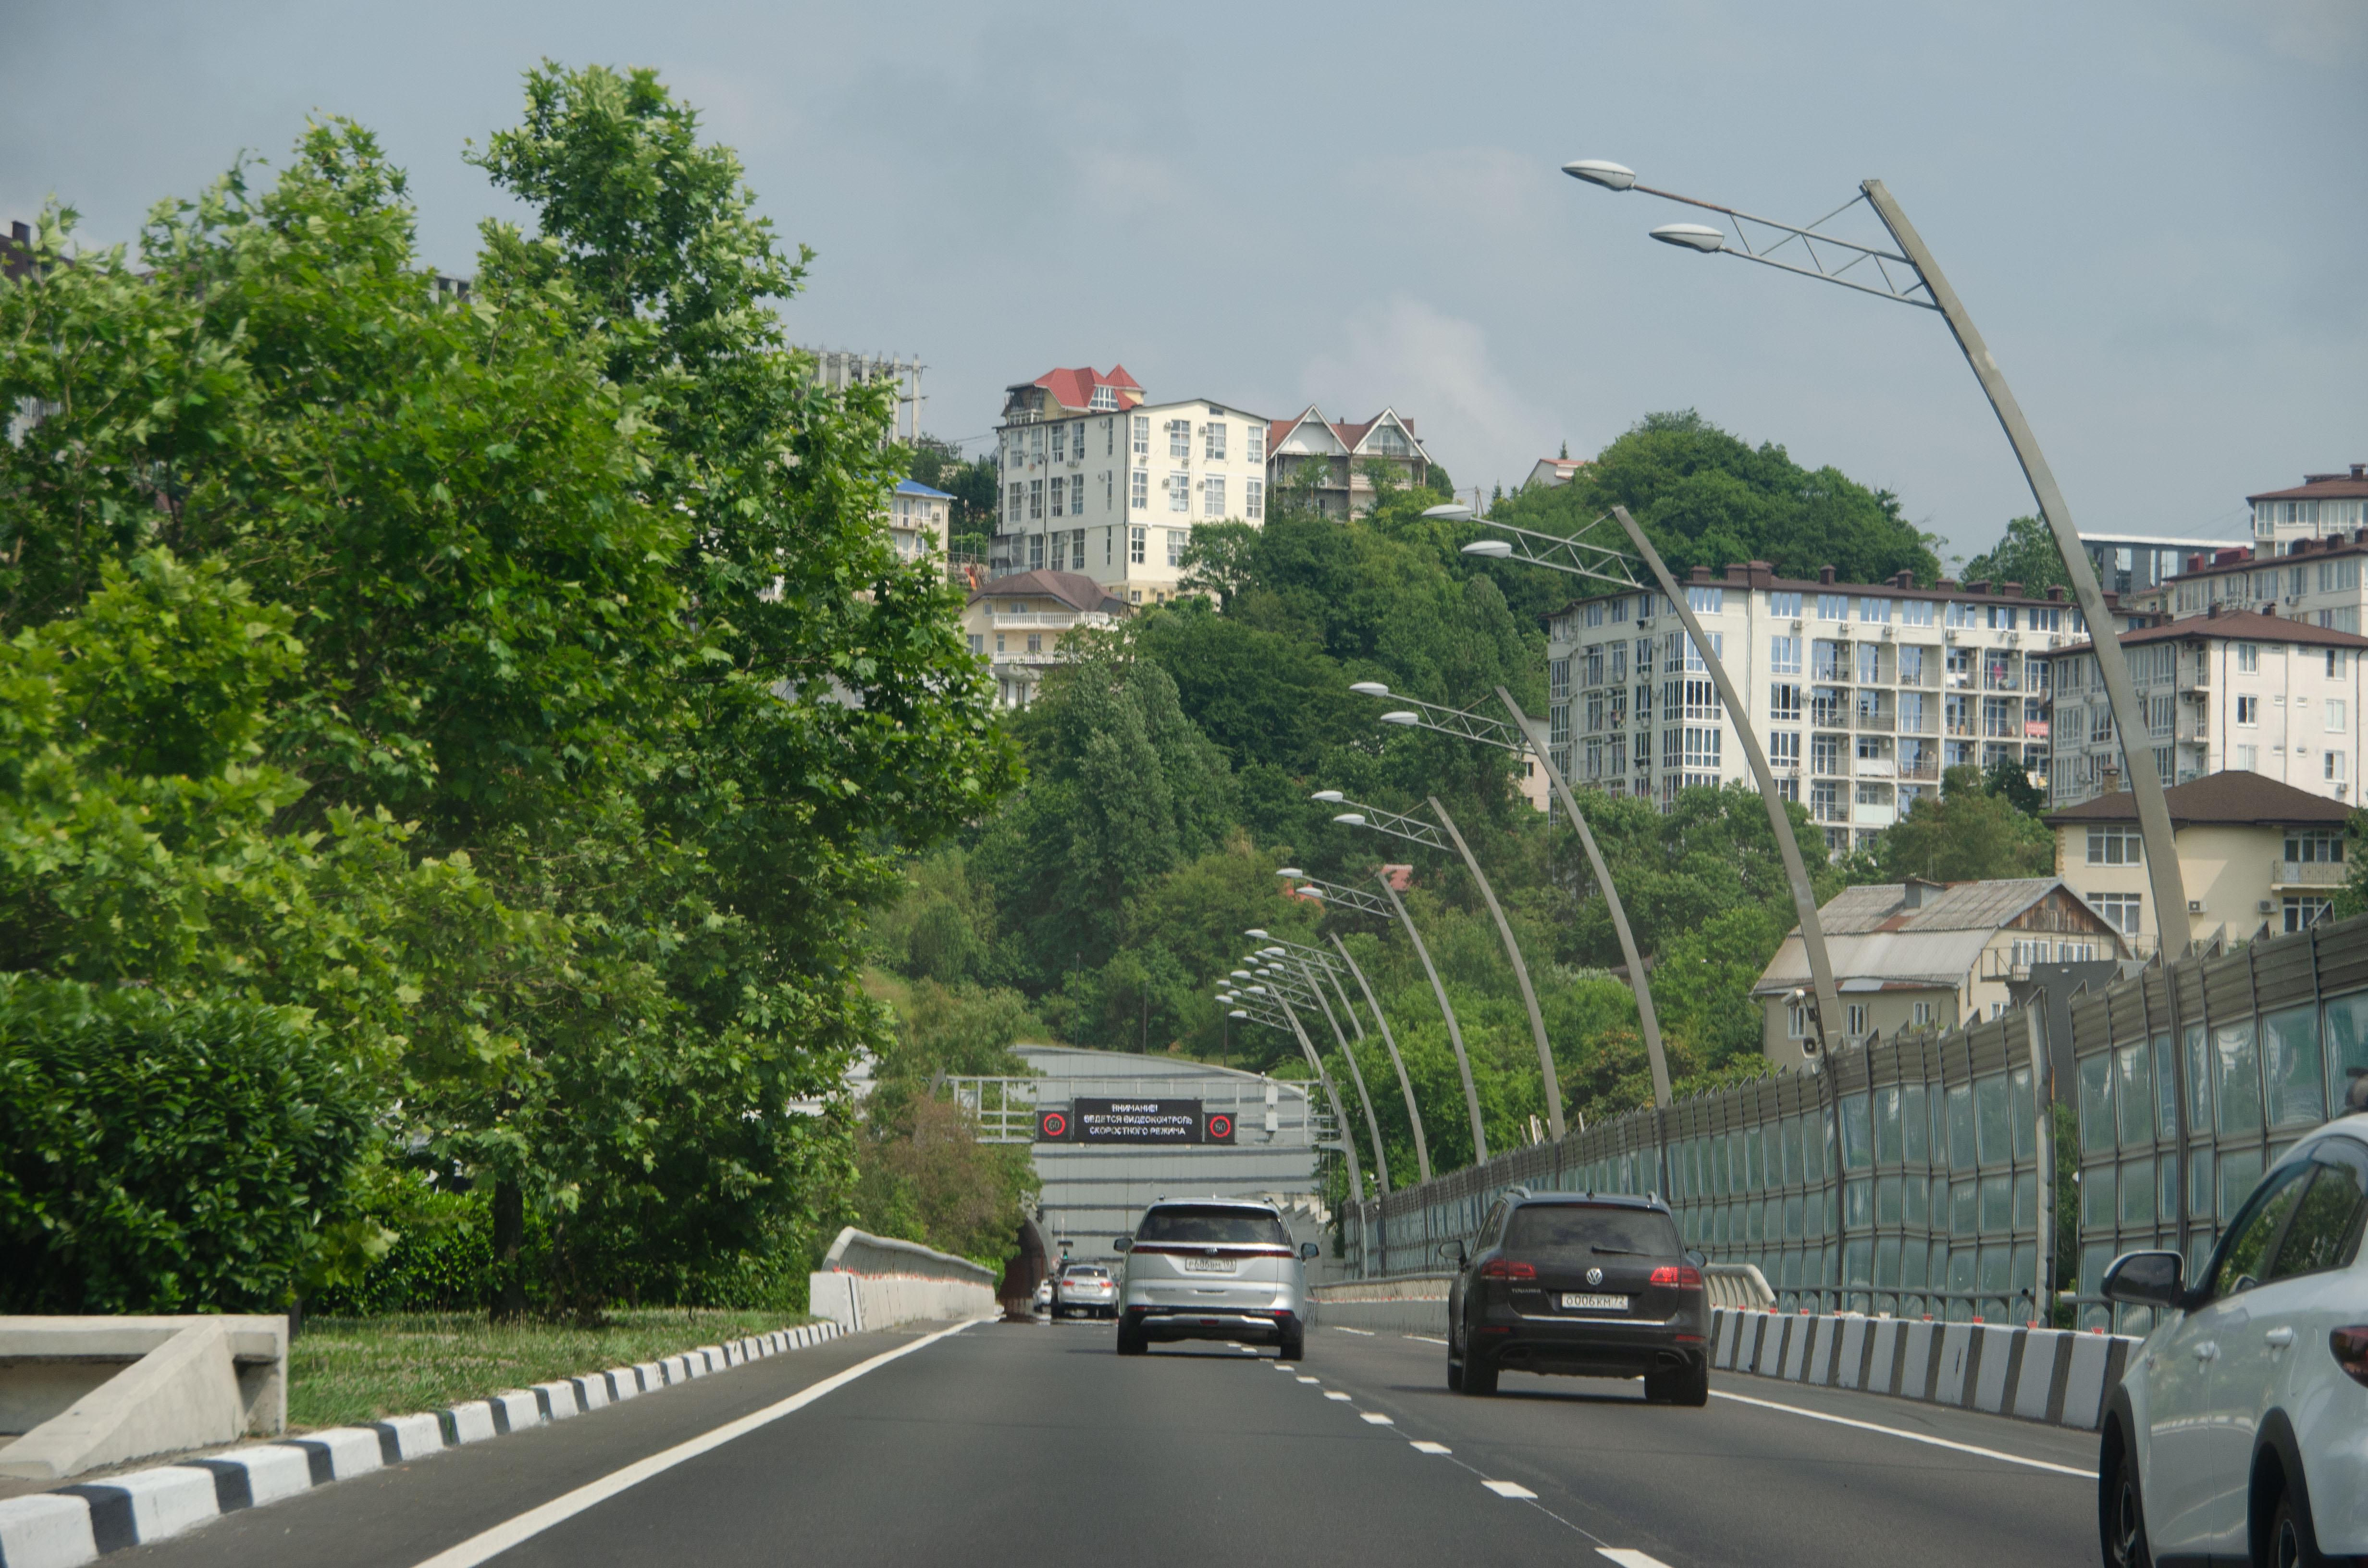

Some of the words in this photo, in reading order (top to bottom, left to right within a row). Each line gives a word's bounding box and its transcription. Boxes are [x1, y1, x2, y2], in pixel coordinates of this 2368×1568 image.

[1112, 1104, 1158, 1113] ВНИМАНИЕ!
[1084, 1115, 1122, 1124] ВЕДЕТСЯ
[1123, 1115, 1193, 1125] ВИДЕОКОНТРОЛЬ
[1090, 1126, 1148, 1135] СКОРОСТНОГО
[1150, 1127, 1186, 1136] РЕЖИМА
